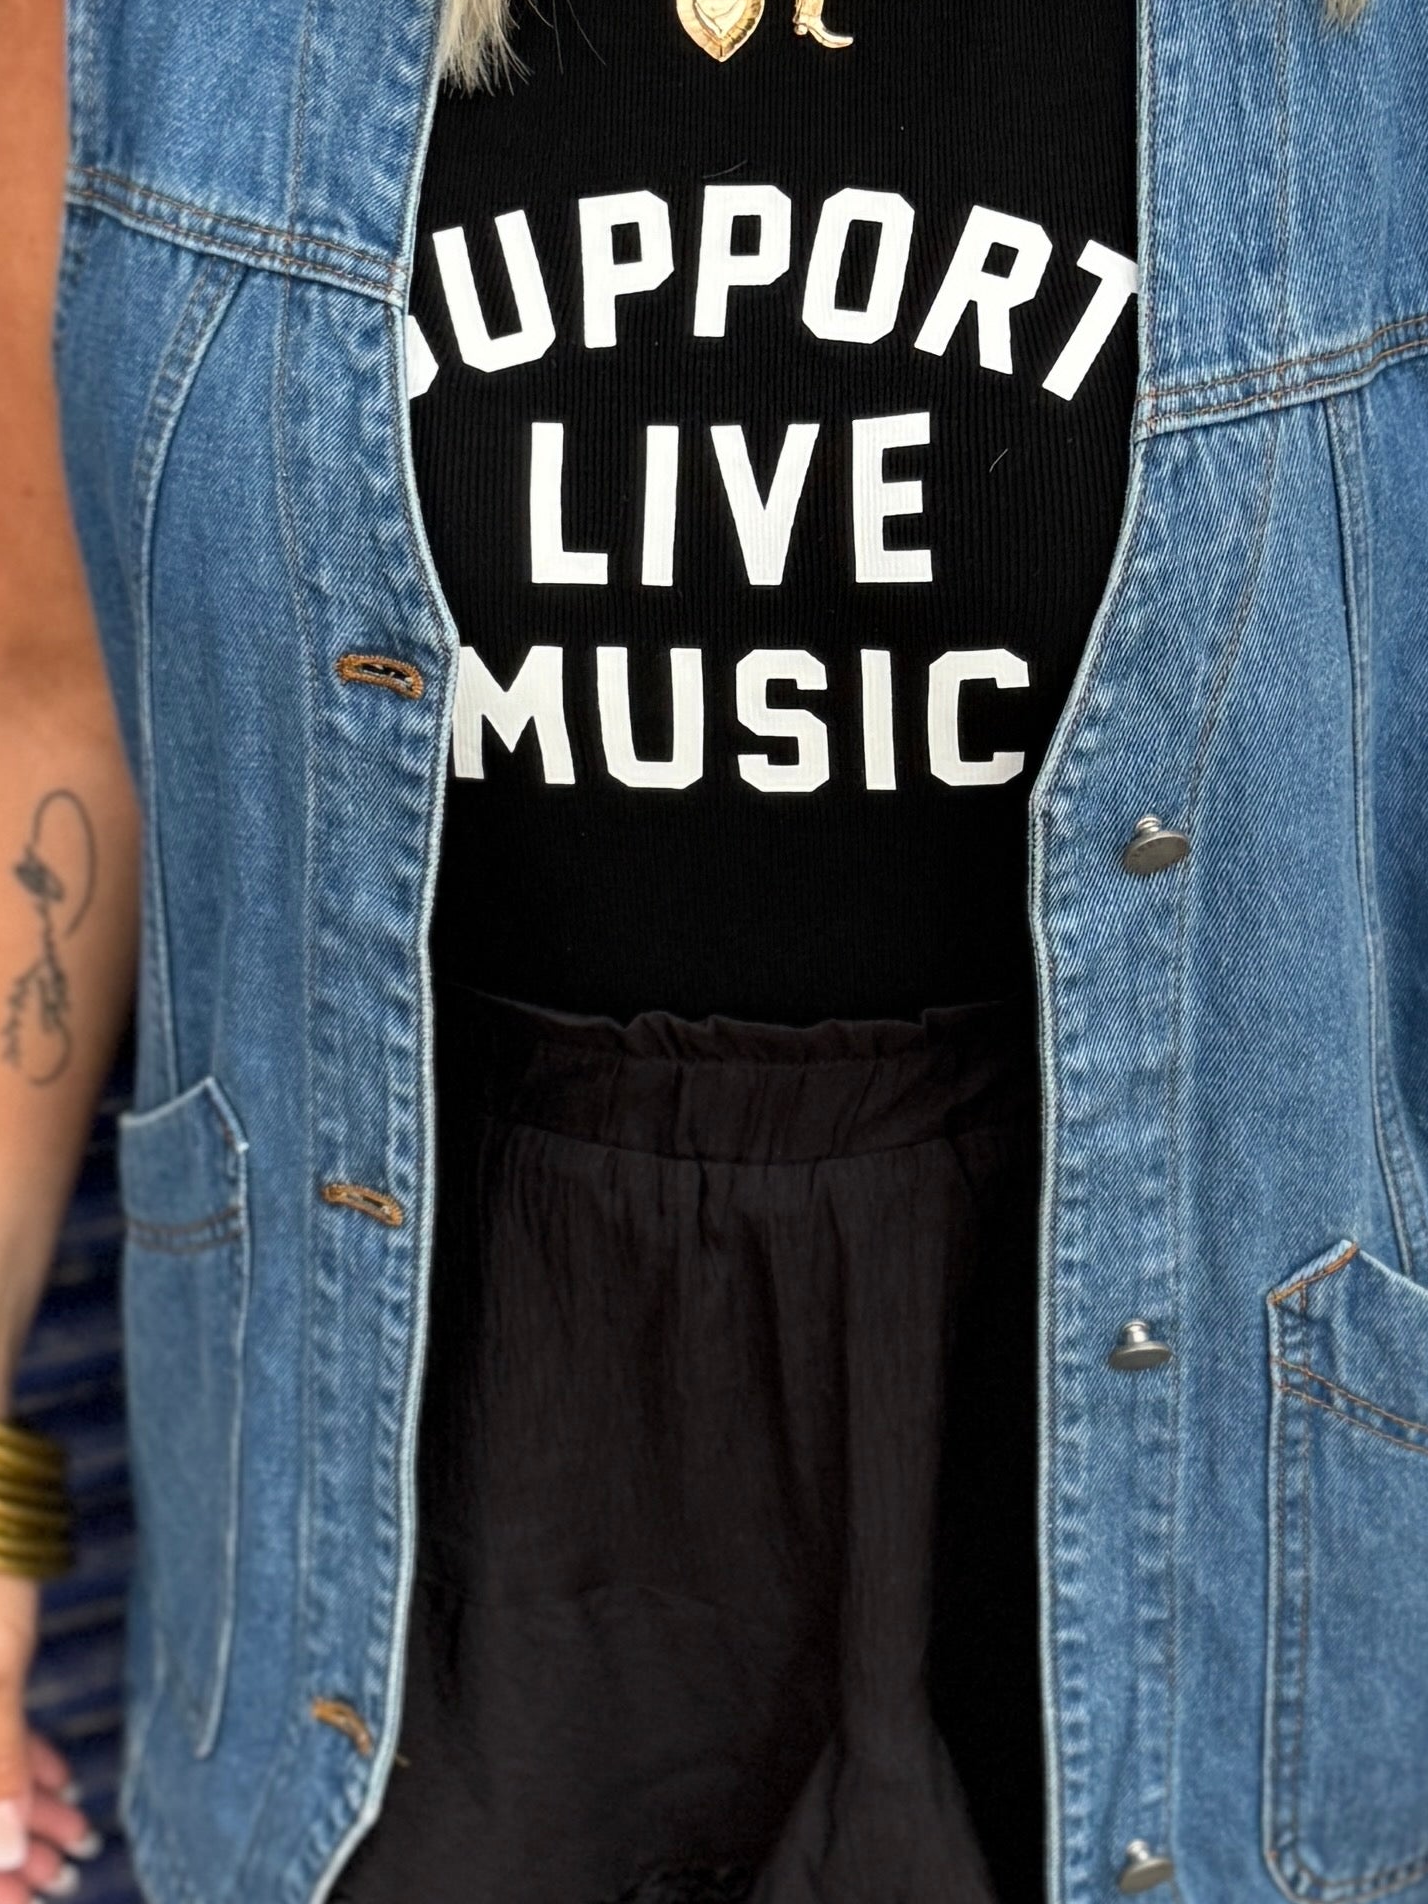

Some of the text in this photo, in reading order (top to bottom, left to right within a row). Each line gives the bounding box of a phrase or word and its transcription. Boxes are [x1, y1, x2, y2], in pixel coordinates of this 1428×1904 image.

[408, 185, 1139, 401] UPPORT
[529, 412, 933, 586] LIVE
[452, 646, 1030, 793] MUSIC
